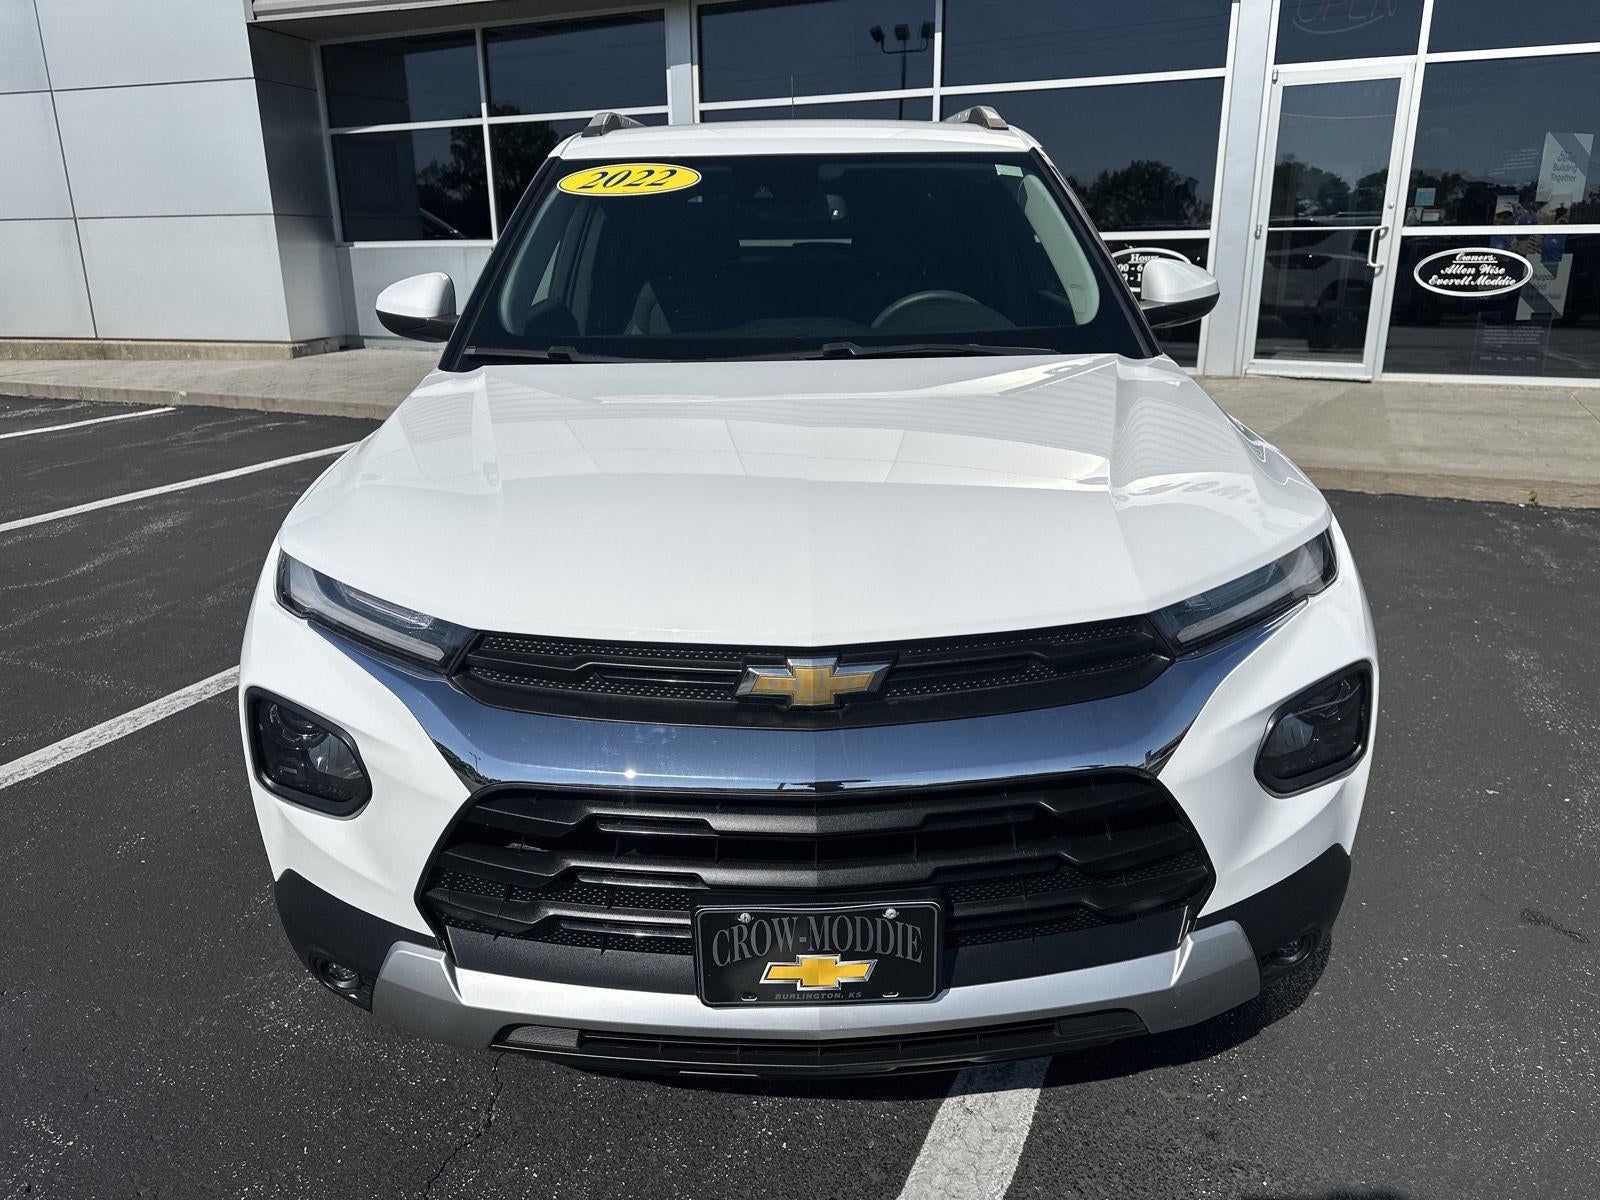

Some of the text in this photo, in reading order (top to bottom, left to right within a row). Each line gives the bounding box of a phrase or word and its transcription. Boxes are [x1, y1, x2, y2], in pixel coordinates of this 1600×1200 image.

[576, 169, 677, 189] 2022
[1440, 263, 1506, 274] Allen Wise
[1428, 275, 1516, 285] Everett Moddie
[712, 915, 923, 967] CROW-MODDIE
